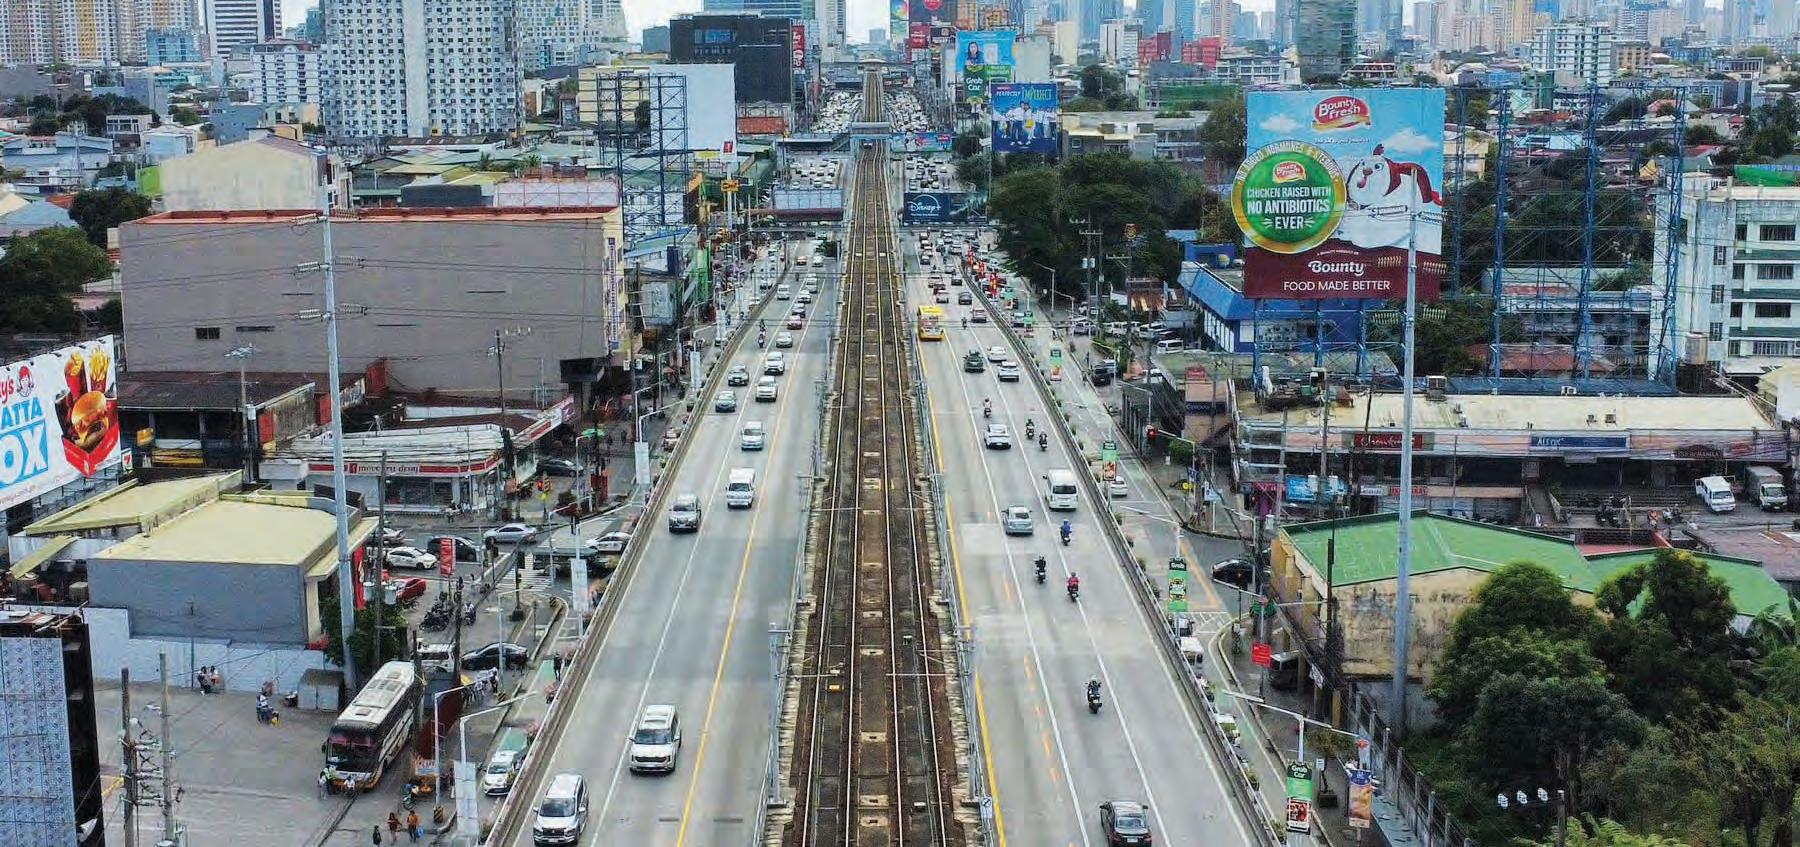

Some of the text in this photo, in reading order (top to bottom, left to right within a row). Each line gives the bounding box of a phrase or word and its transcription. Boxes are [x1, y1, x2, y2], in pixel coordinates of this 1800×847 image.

[1319, 99, 1356, 117] Bounty
[1247, 186, 1332, 198] CHICKEN RAISED WITH
[1247, 199, 1330, 215] NO ANTIBIOTICS
[1275, 216, 1304, 230] EVER
[1308, 260, 1365, 277] Bounty
[1284, 281, 1391, 291] FOOD MADE BETTER
[1291, 764, 1308, 773] Grab
